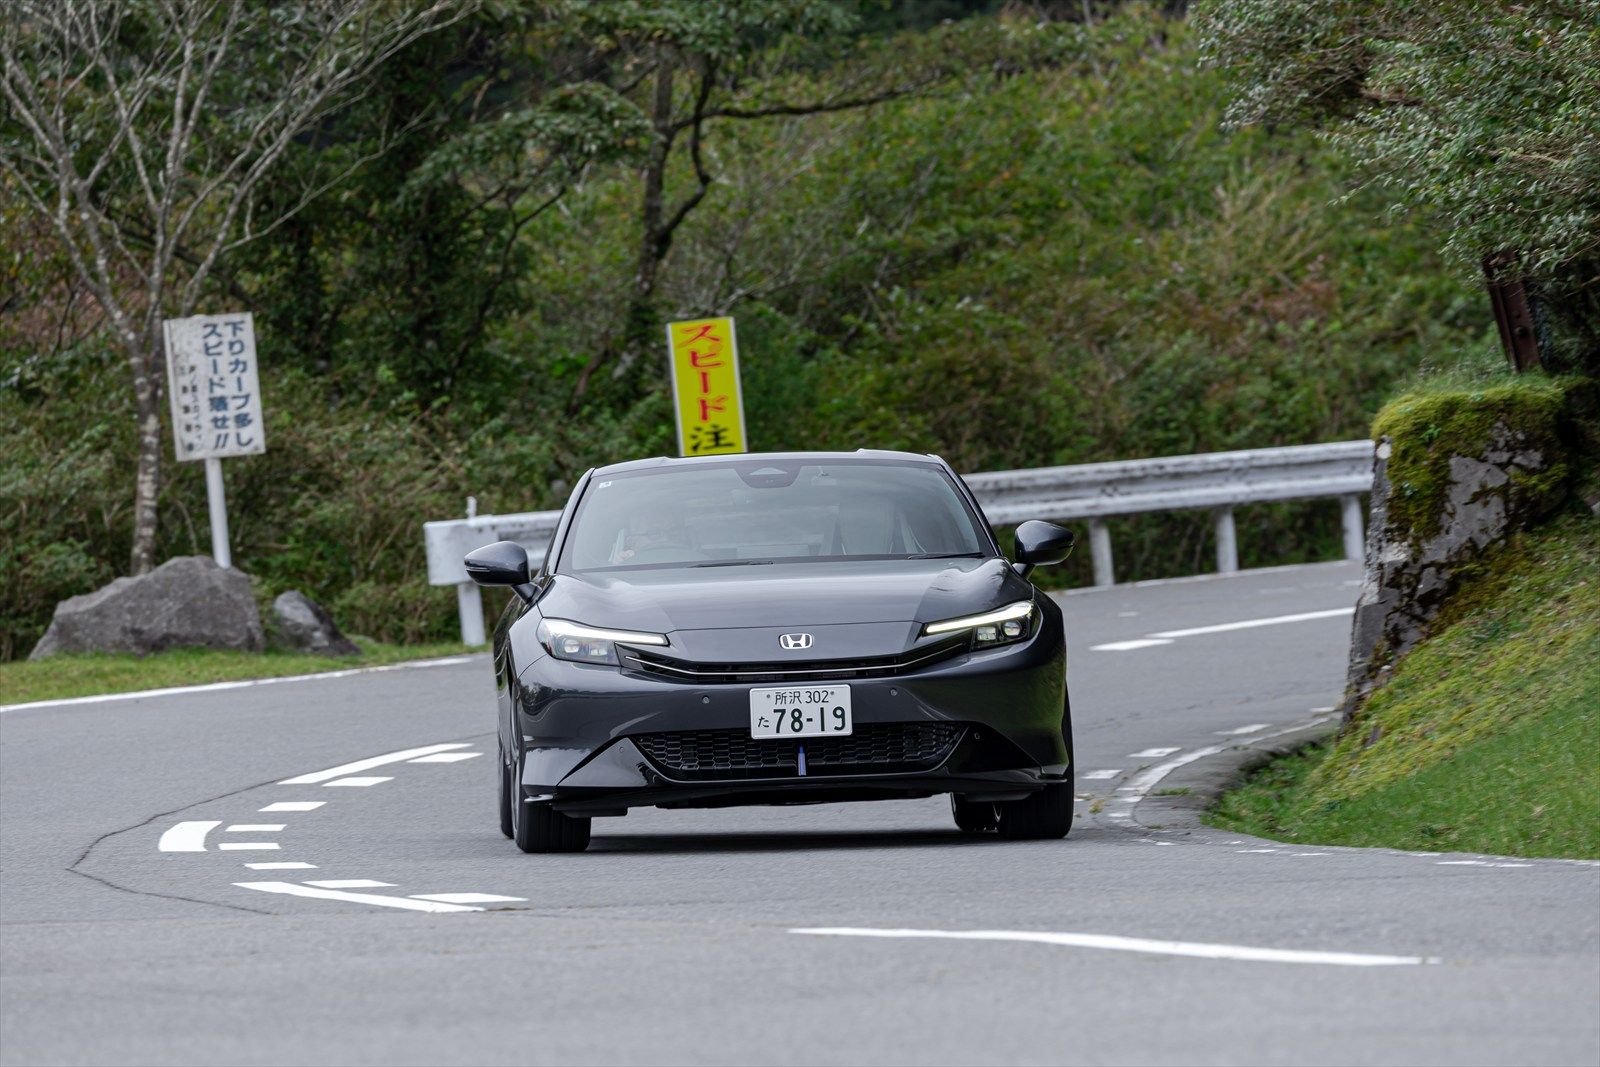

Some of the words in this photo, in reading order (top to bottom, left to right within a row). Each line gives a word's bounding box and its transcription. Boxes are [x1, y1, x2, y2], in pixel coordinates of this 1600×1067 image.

[775, 691, 802, 705] 所沢
[805, 690, 829, 704] 302
[758, 716, 770, 728] た
[773, 706, 846, 734] 78-19
